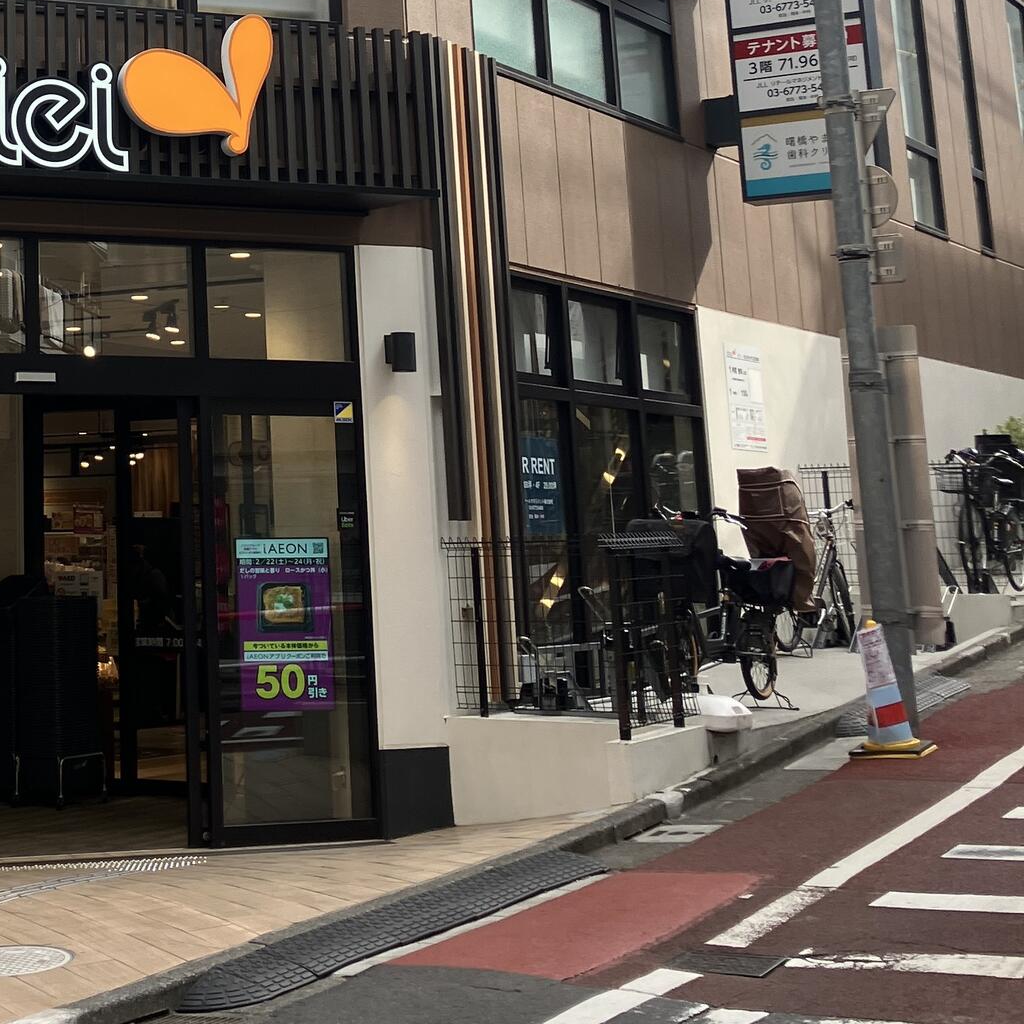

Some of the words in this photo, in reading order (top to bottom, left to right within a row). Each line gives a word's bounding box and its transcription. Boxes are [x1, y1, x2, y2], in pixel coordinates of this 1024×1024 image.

[760, 0, 814, 14] 03-6773-54
[747, 32, 817, 55] テナント募
[748, 60, 773, 75] 3階
[767, 83, 824, 97] 03-6773-54
[531, 457, 555, 475] RENT
[263, 543, 308, 554] iAEON
[256, 664, 305, 700] 50
[307, 674, 318, 686] 円
[307, 687, 328, 699] 引き
